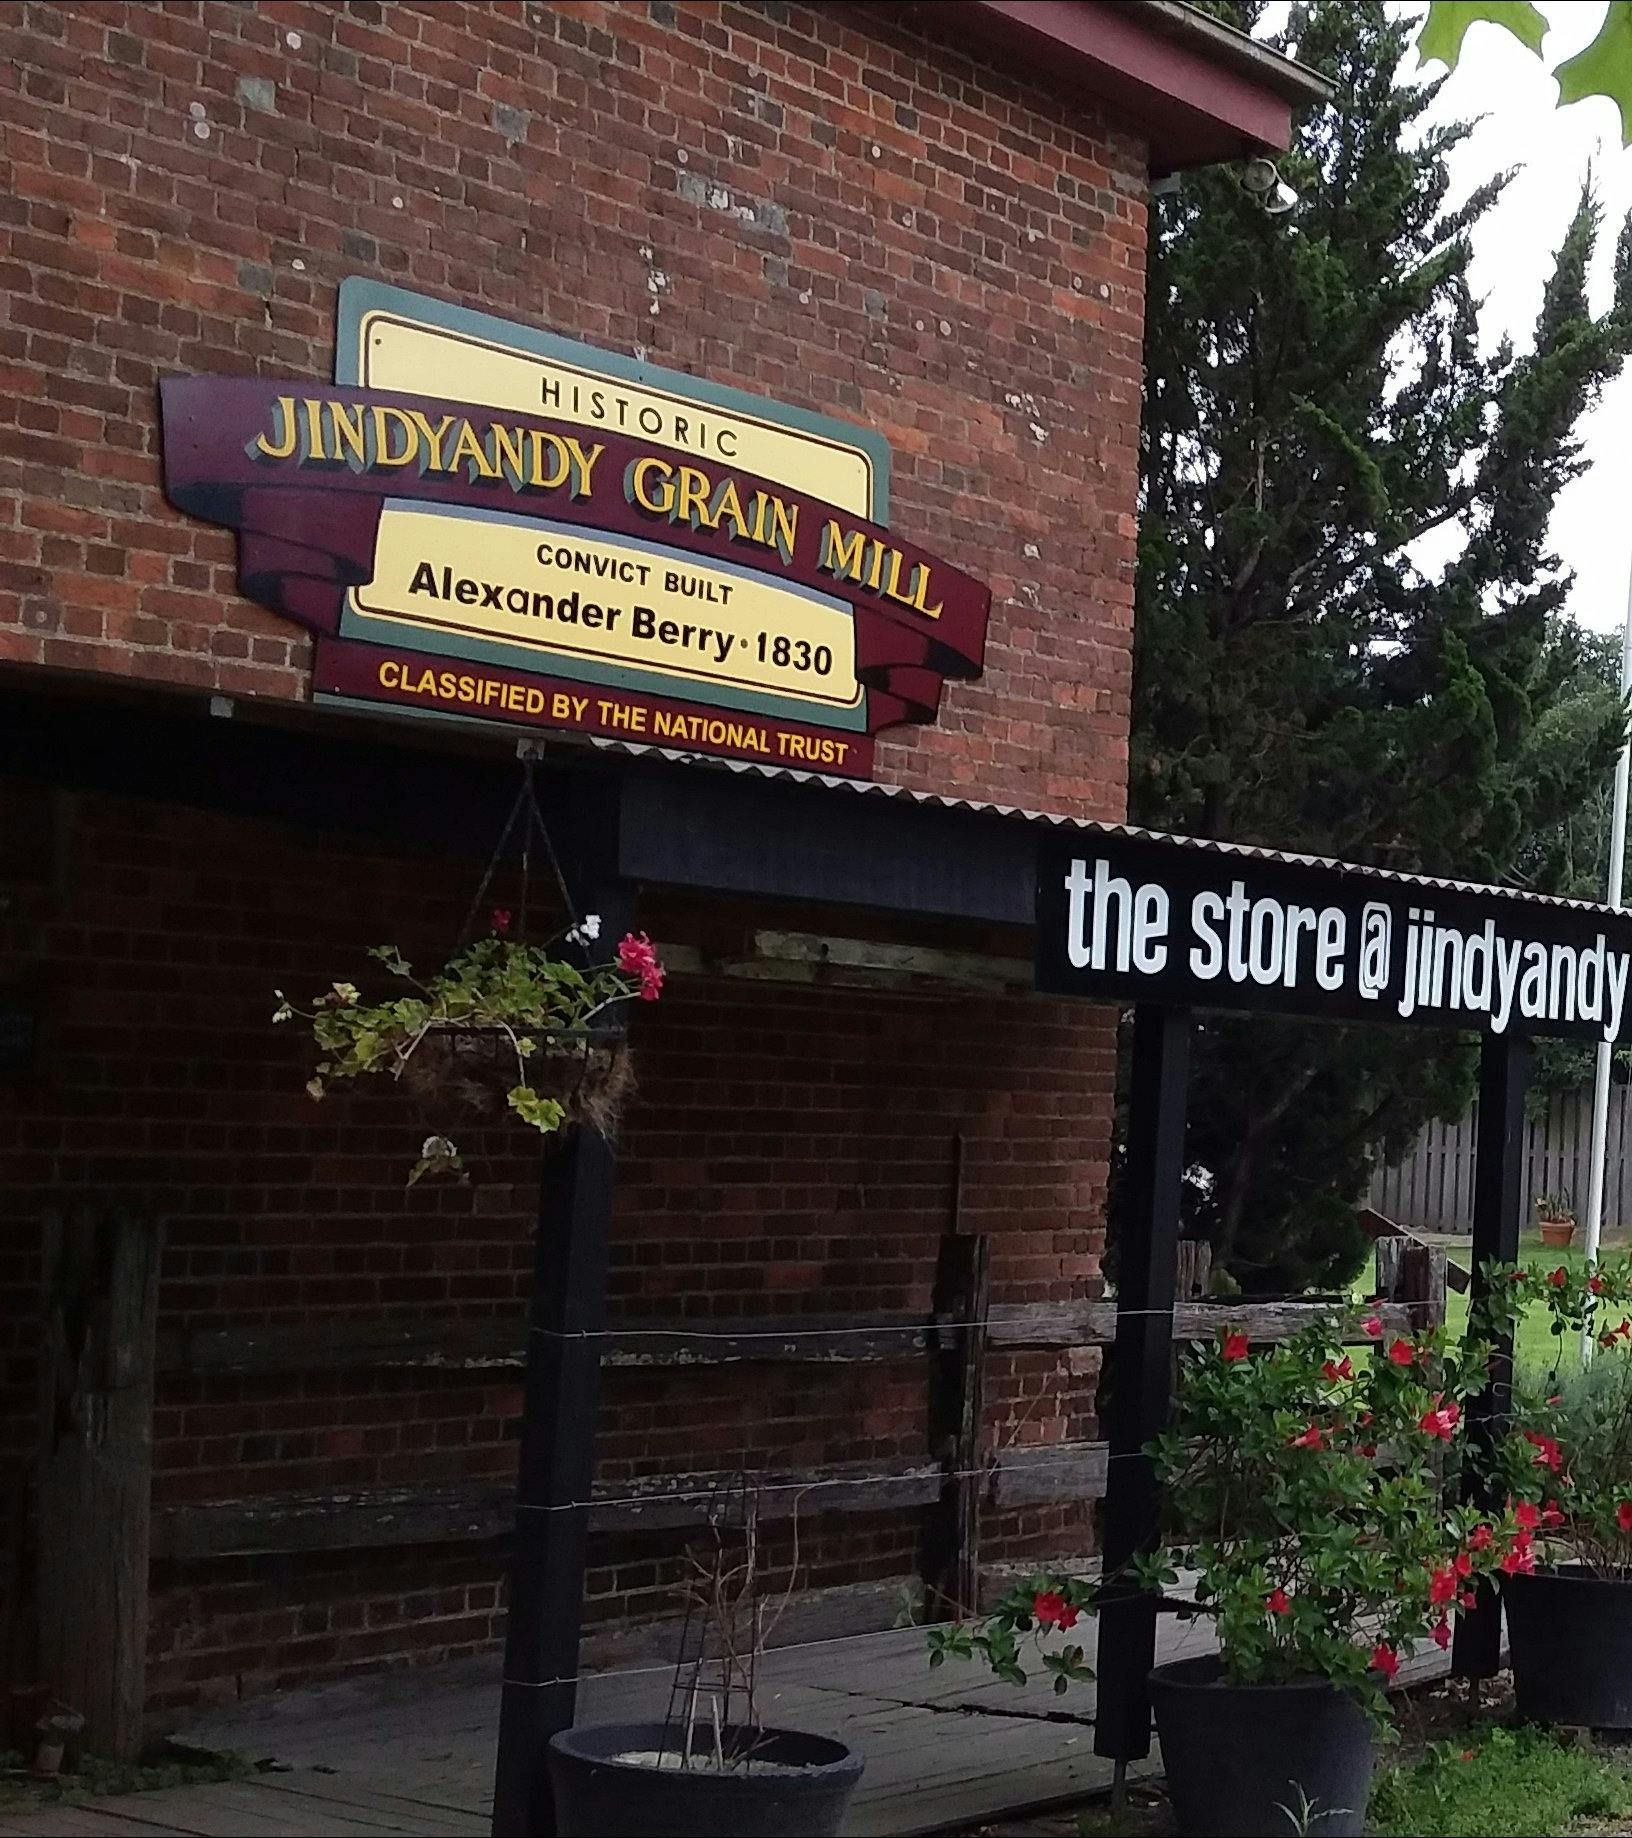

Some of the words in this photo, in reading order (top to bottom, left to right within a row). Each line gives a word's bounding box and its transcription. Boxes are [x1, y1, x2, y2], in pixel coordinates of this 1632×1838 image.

[541, 376, 738, 457] HISTORIC
[254, 396, 606, 498] JINDYANDY
[632, 457, 799, 556] GRAIN
[823, 518, 945, 620] MILL
[407, 561, 622, 631] Alexander
[631, 605, 735, 663] Berry
[757, 631, 833, 676] 1830
[536, 543, 652, 586] CONVICT
[663, 571, 734, 605] BUILT
[378, 660, 545, 715] CLASSIFIED
[551, 694, 589, 722] BY
[597, 700, 649, 732] THE
[653, 710, 771, 754] NATIONAL
[776, 732, 849, 765] TRUST
[1064, 858, 1170, 975] the
[1189, 880, 1346, 991] store
[1359, 900, 1393, 1000] @
[1397, 907, 1631, 1043] jindyandy
